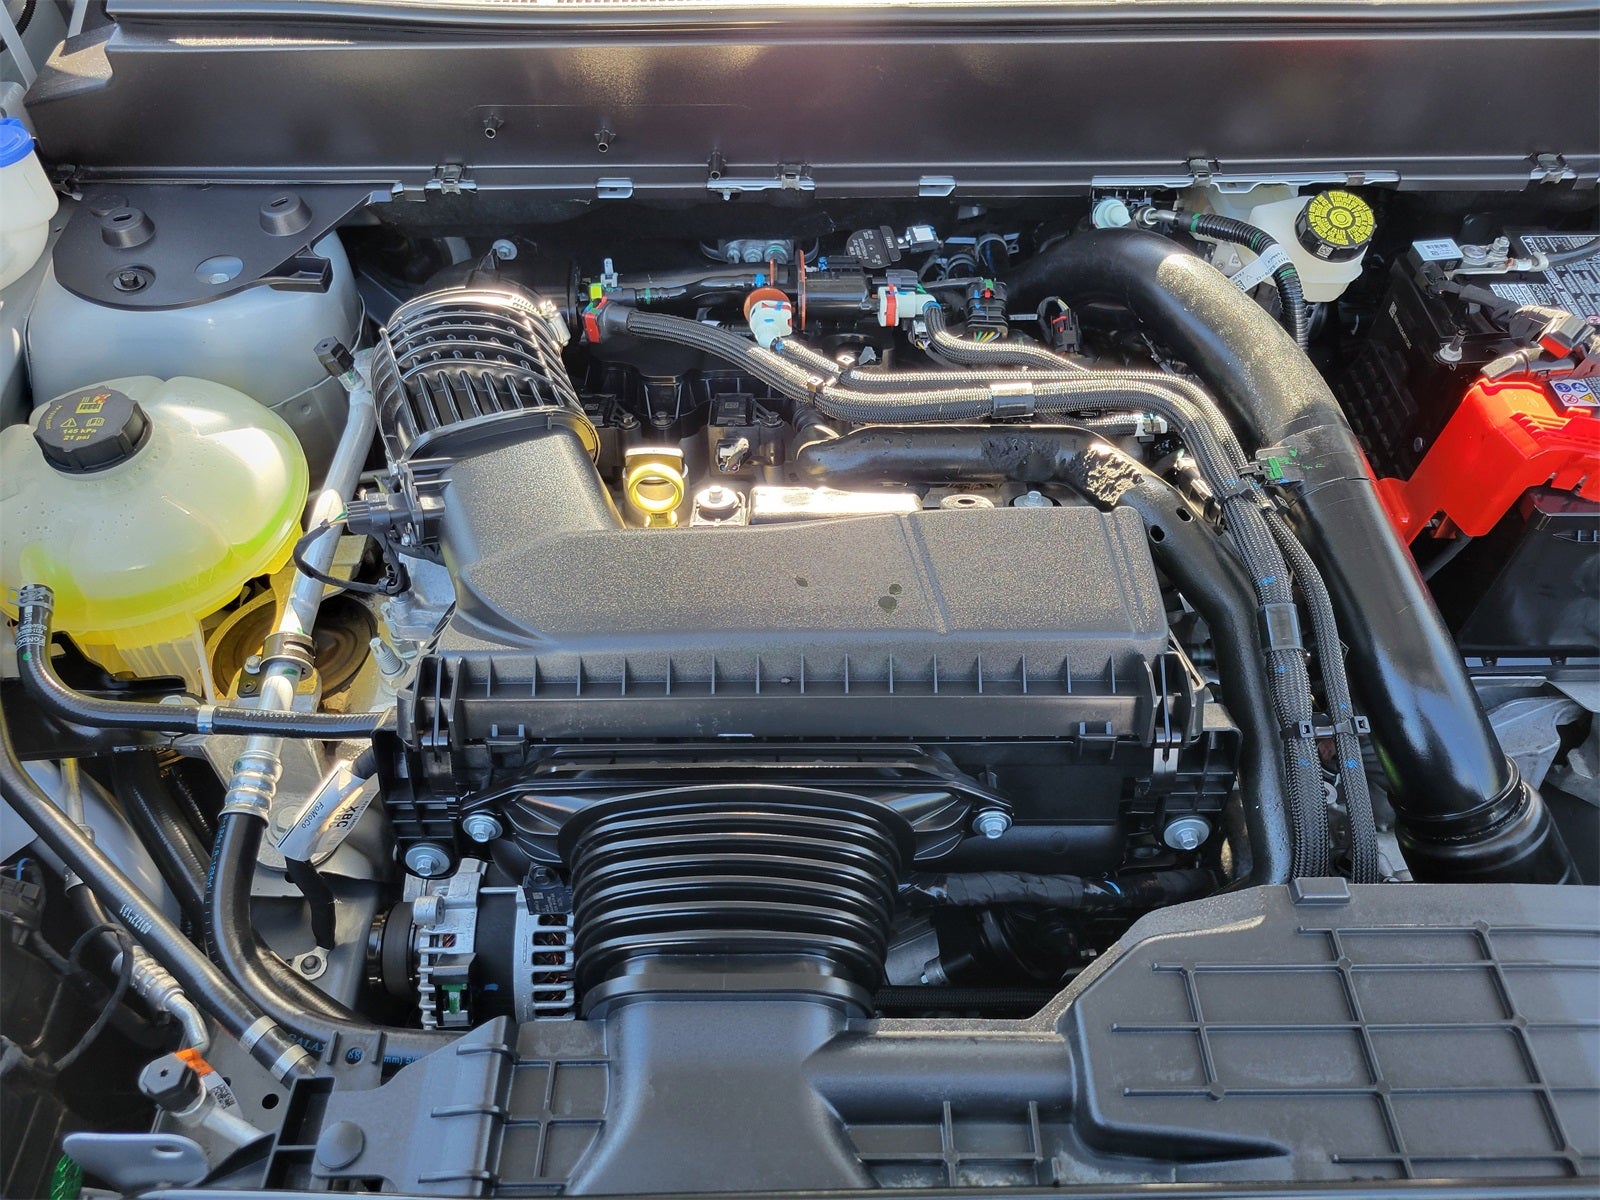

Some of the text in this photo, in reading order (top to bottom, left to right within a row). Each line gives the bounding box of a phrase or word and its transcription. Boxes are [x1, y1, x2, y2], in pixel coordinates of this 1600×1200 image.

[16, 636, 46, 647] FoMoC
[301, 802, 325, 829] FoMoCo
[336, 804, 359, 829] XBC
